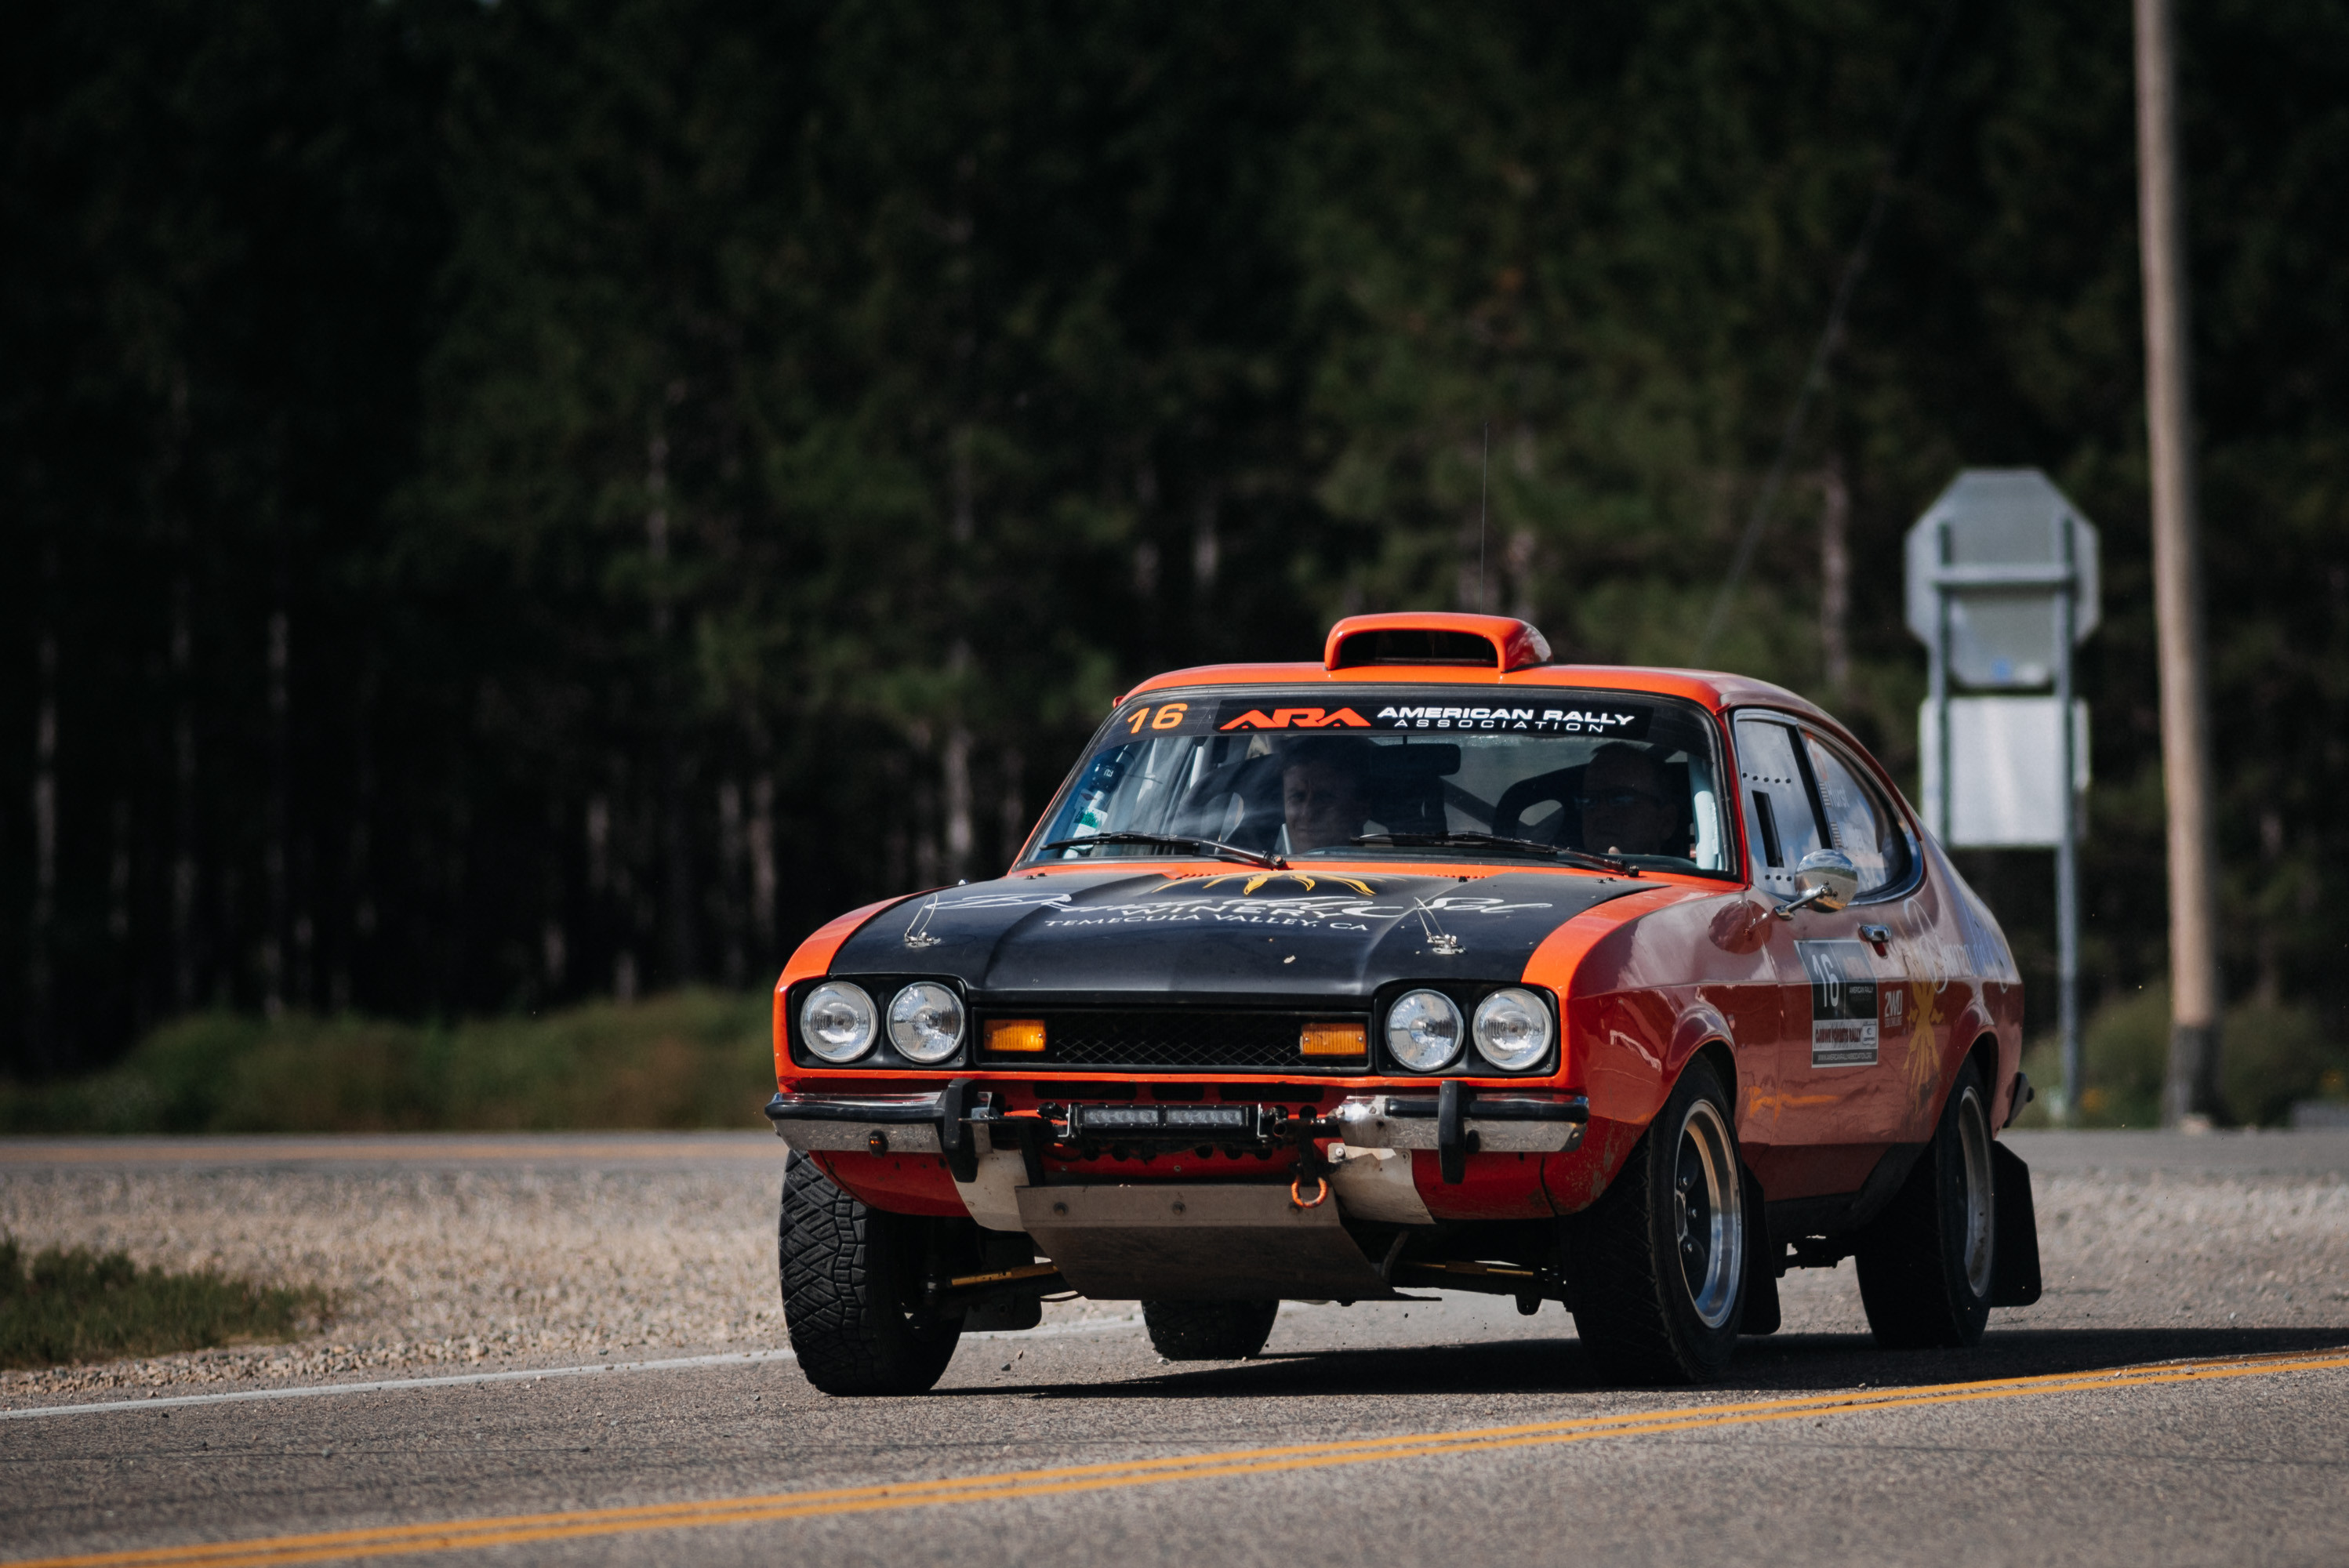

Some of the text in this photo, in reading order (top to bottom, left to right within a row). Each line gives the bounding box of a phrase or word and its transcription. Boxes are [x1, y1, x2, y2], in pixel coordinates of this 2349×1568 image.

[1127, 702, 1188, 734] 16
[1219, 707, 1371, 730] ARA
[1377, 706, 1636, 726] AMERICAN RALLY
[1394, 719, 1604, 733] ASSOCIATION
[1044, 913, 1369, 931] TEMECULA VALLEY, CA
[1120, 904, 1345, 920] WINERY
[1812, 953, 1839, 1007] 16
[1884, 989, 1903, 1018] 2WD
[1849, 1027, 1863, 1043] RALLY
